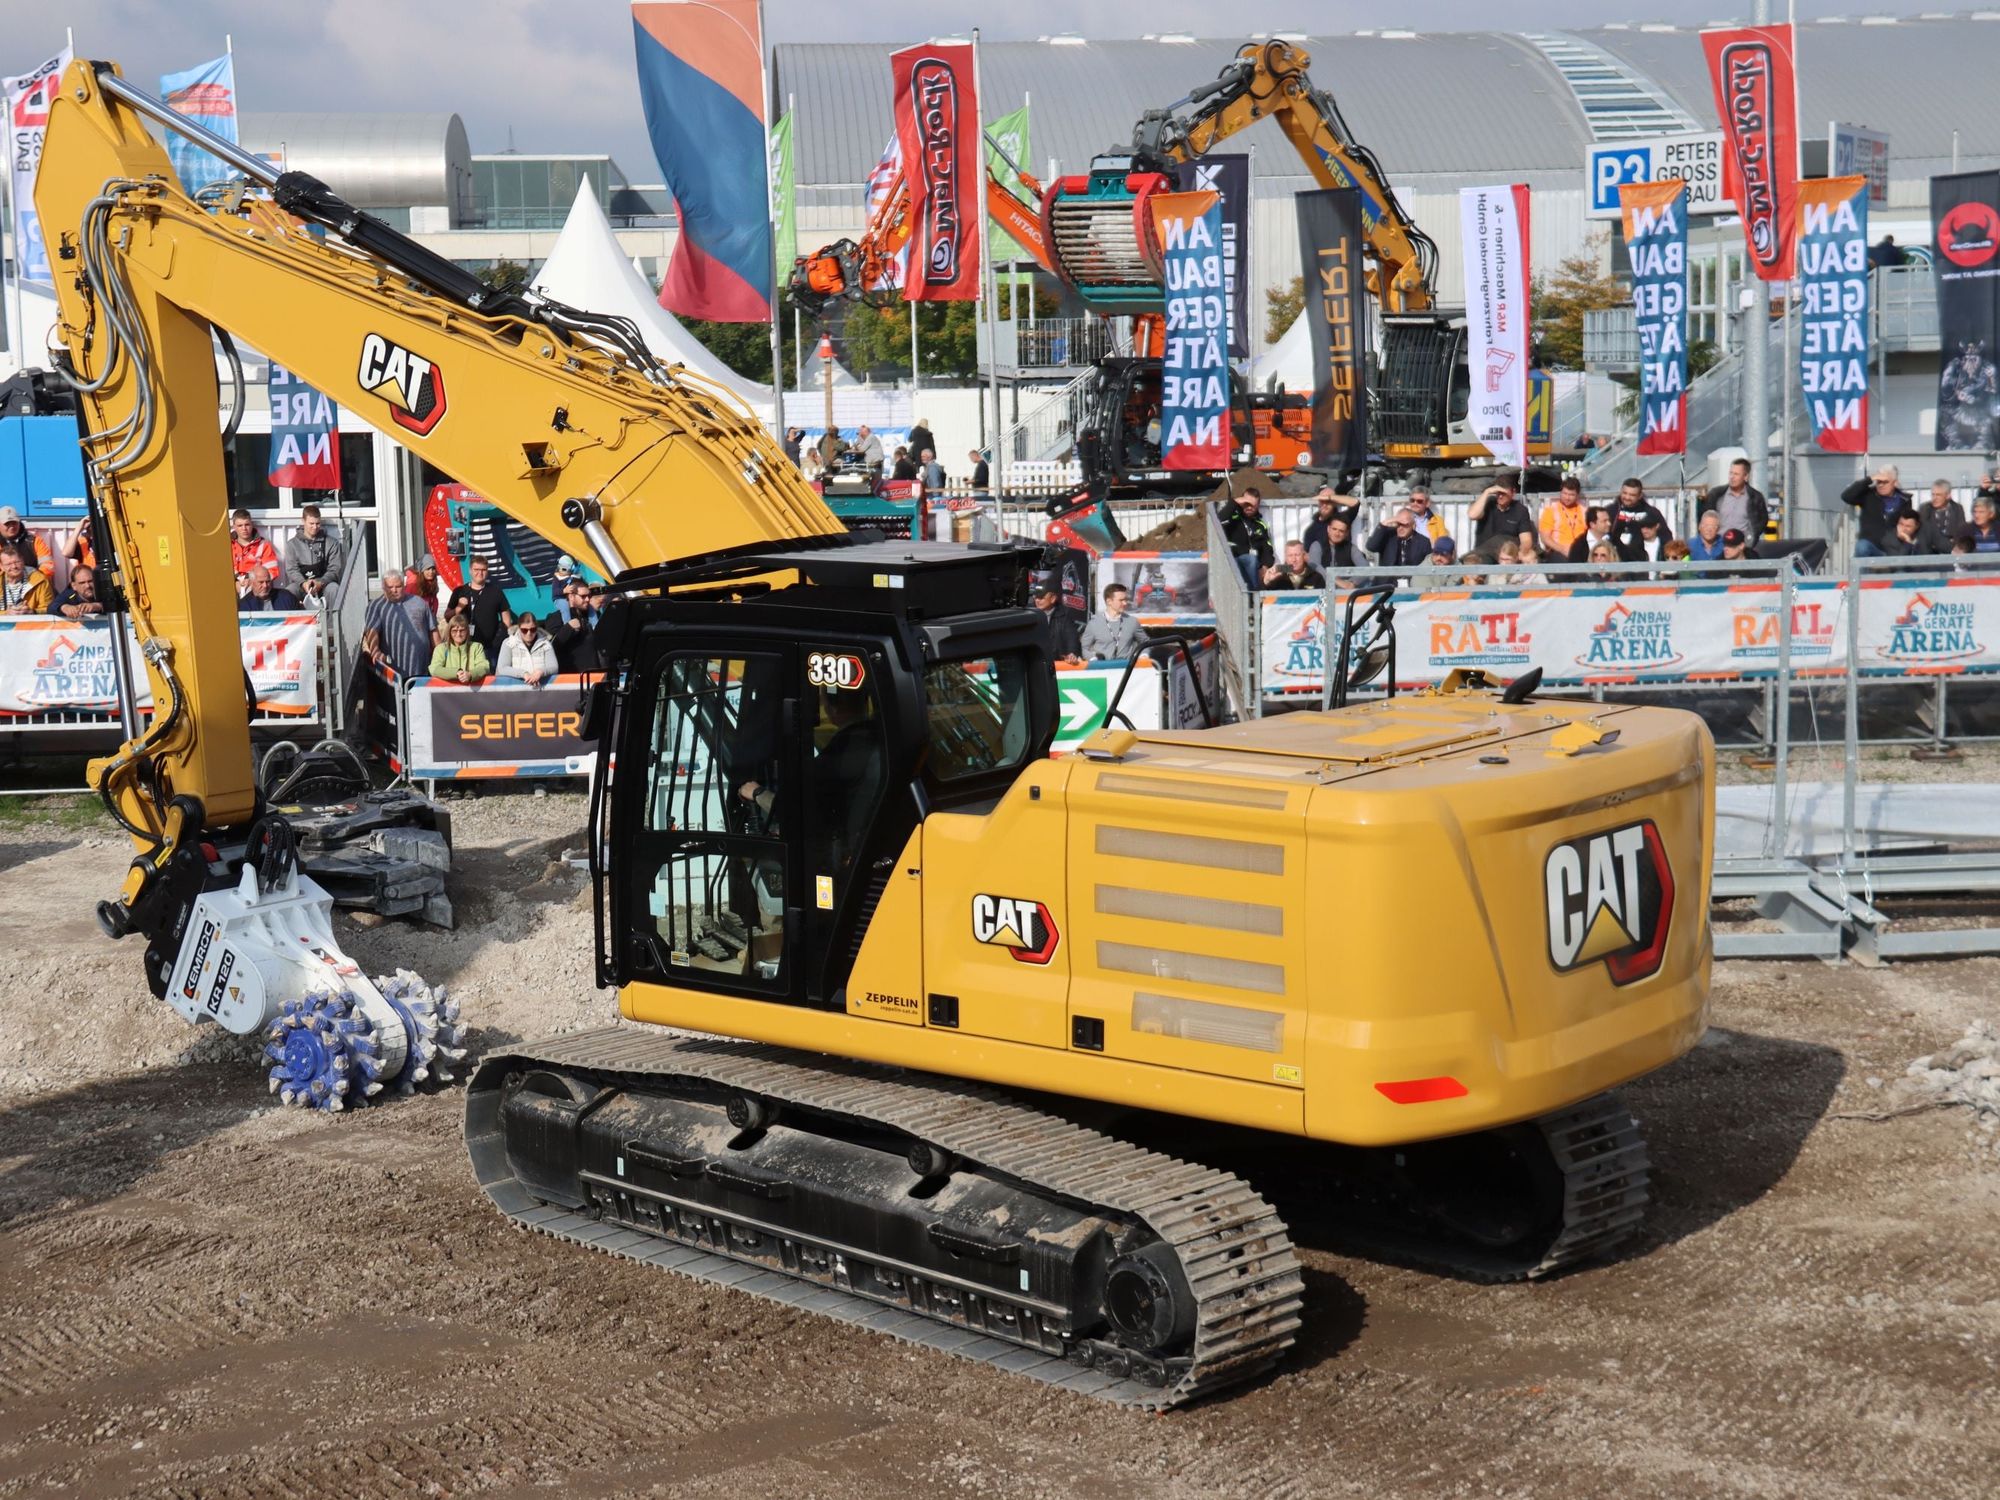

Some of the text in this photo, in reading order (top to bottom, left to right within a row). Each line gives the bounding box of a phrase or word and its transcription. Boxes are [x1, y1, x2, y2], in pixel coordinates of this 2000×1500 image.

[1666, 141, 1717, 161] PETER
[1657, 163, 1717, 183] GROSS
[359, 333, 431, 413] CAT
[1624, 610, 1671, 624] ANBAU
[1926, 602, 1974, 616] ANBAU
[1430, 612, 1532, 655] RATL
[1889, 630, 1976, 654] ARENA
[1587, 638, 1673, 662] ARENA
[808, 655, 851, 686] 330
[1546, 824, 1644, 968] CAT
[973, 895, 1039, 948] CAT
[185, 923, 214, 998] KEMROC
[208, 952, 233, 1012] KR 120
[866, 992, 918, 1009] ZEPPELIN
